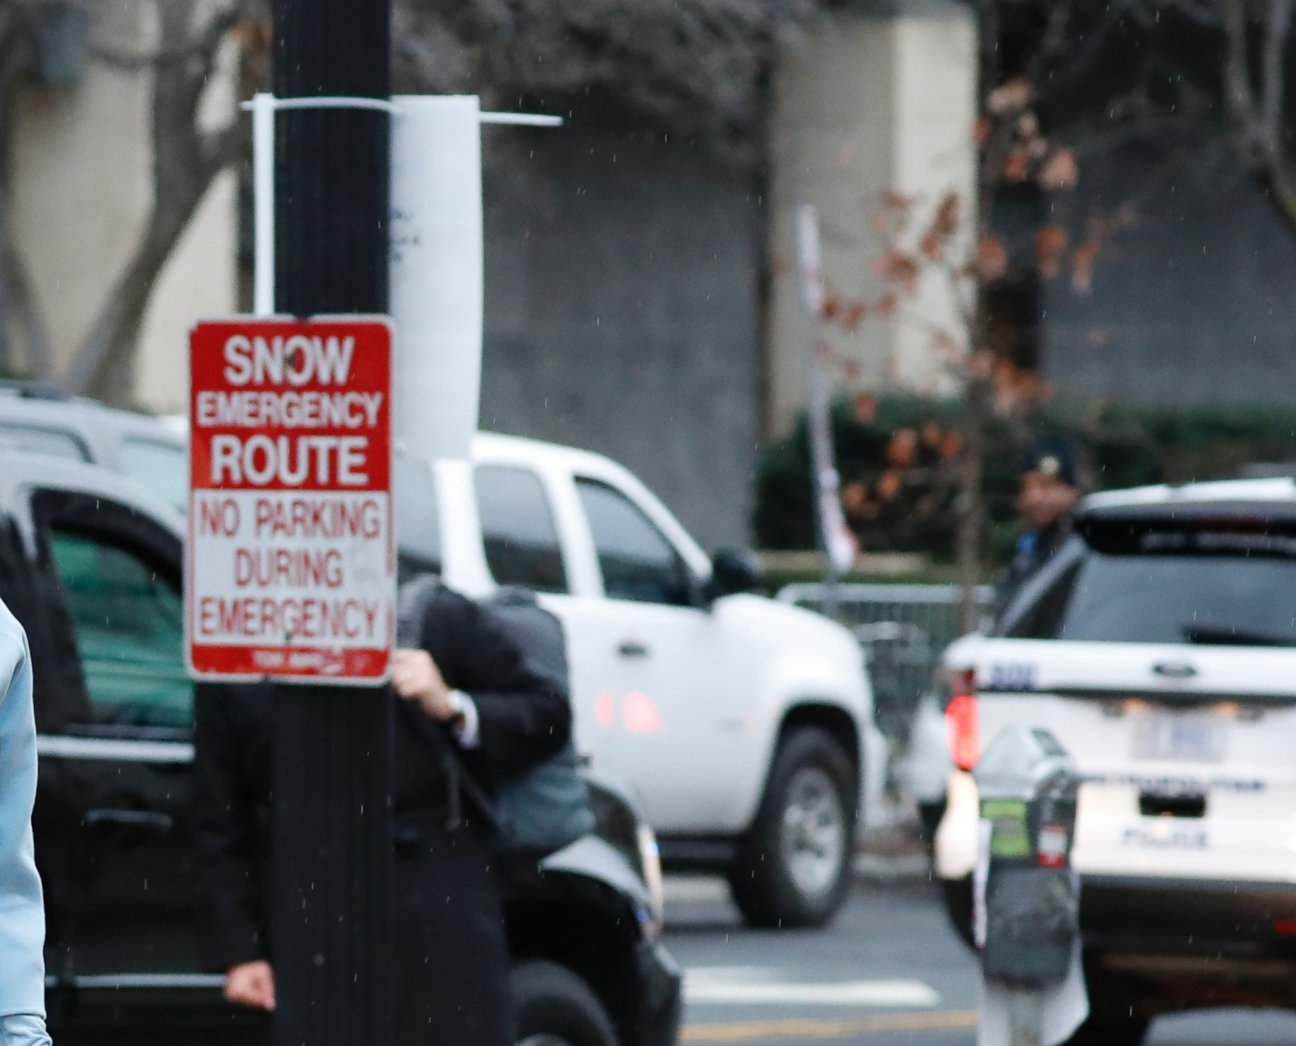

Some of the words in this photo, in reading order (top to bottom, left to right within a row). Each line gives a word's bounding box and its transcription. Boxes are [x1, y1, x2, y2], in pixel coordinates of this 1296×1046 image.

[223, 334, 355, 386] SNOW
[196, 390, 383, 430] EMERGENCY
[210, 434, 370, 486] ROUTE
[200, 500, 240, 537] NO
[255, 499, 381, 539] PARKING
[235, 549, 344, 589] DURING
[200, 599, 379, 640] EMERGENCY
